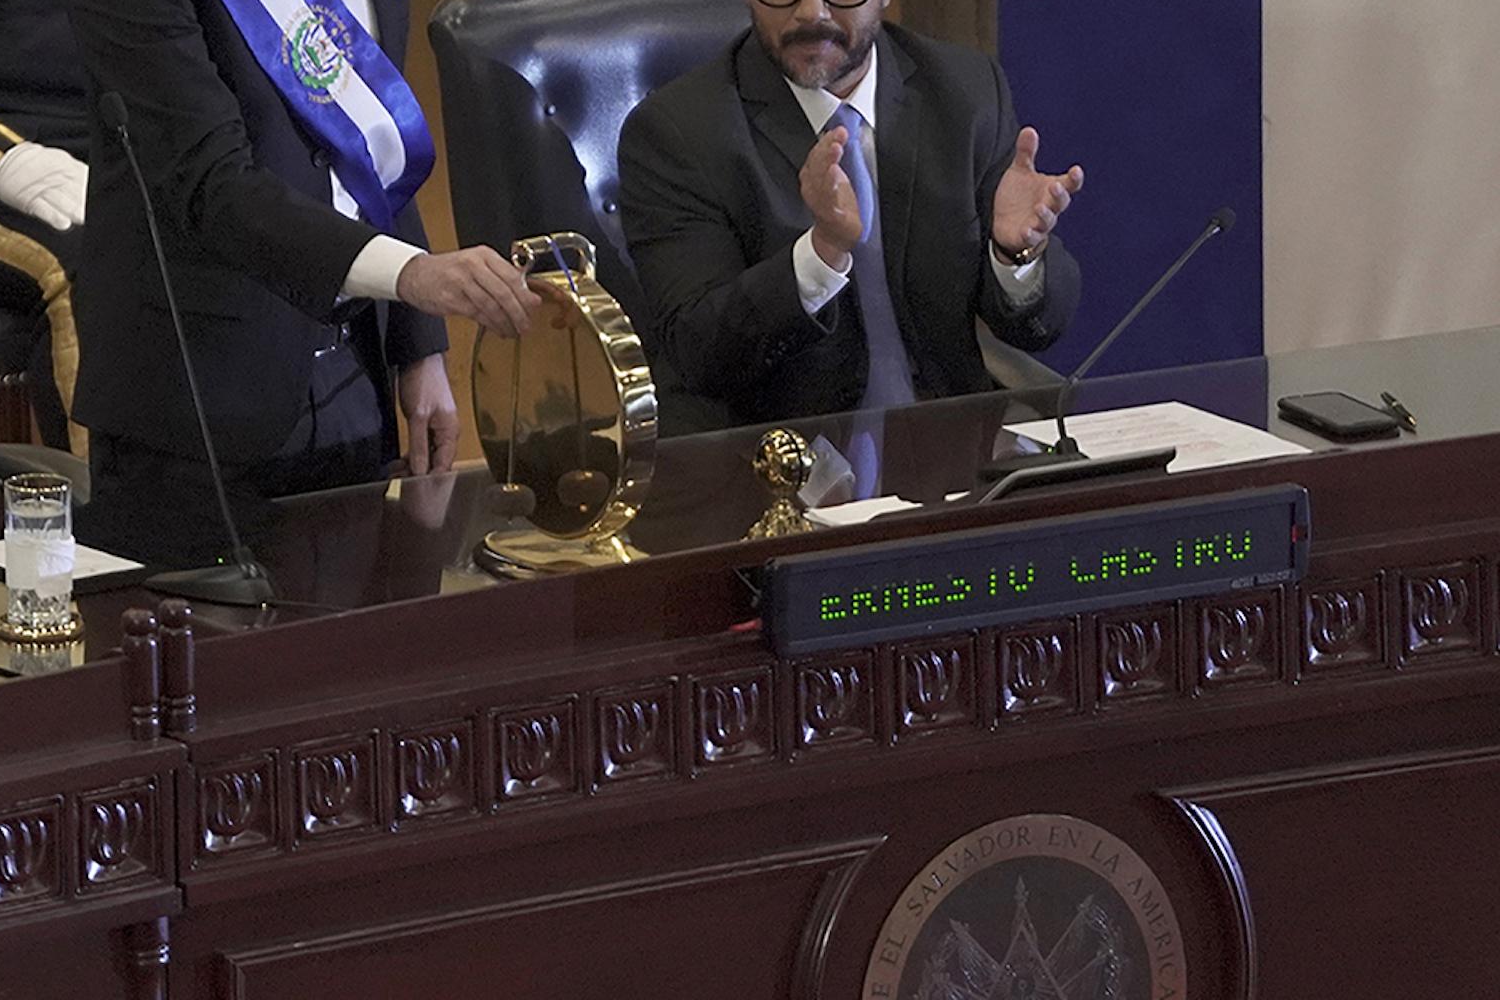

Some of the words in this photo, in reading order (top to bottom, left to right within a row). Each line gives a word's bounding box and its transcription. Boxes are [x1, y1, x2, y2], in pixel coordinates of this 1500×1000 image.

[880, 935, 907, 964] EL
[908, 826, 1032, 916] SALVADOR
[1048, 827, 1083, 848] EN
[1090, 842, 1119, 875] LA
[1127, 877, 1178, 1000] AMERICA
